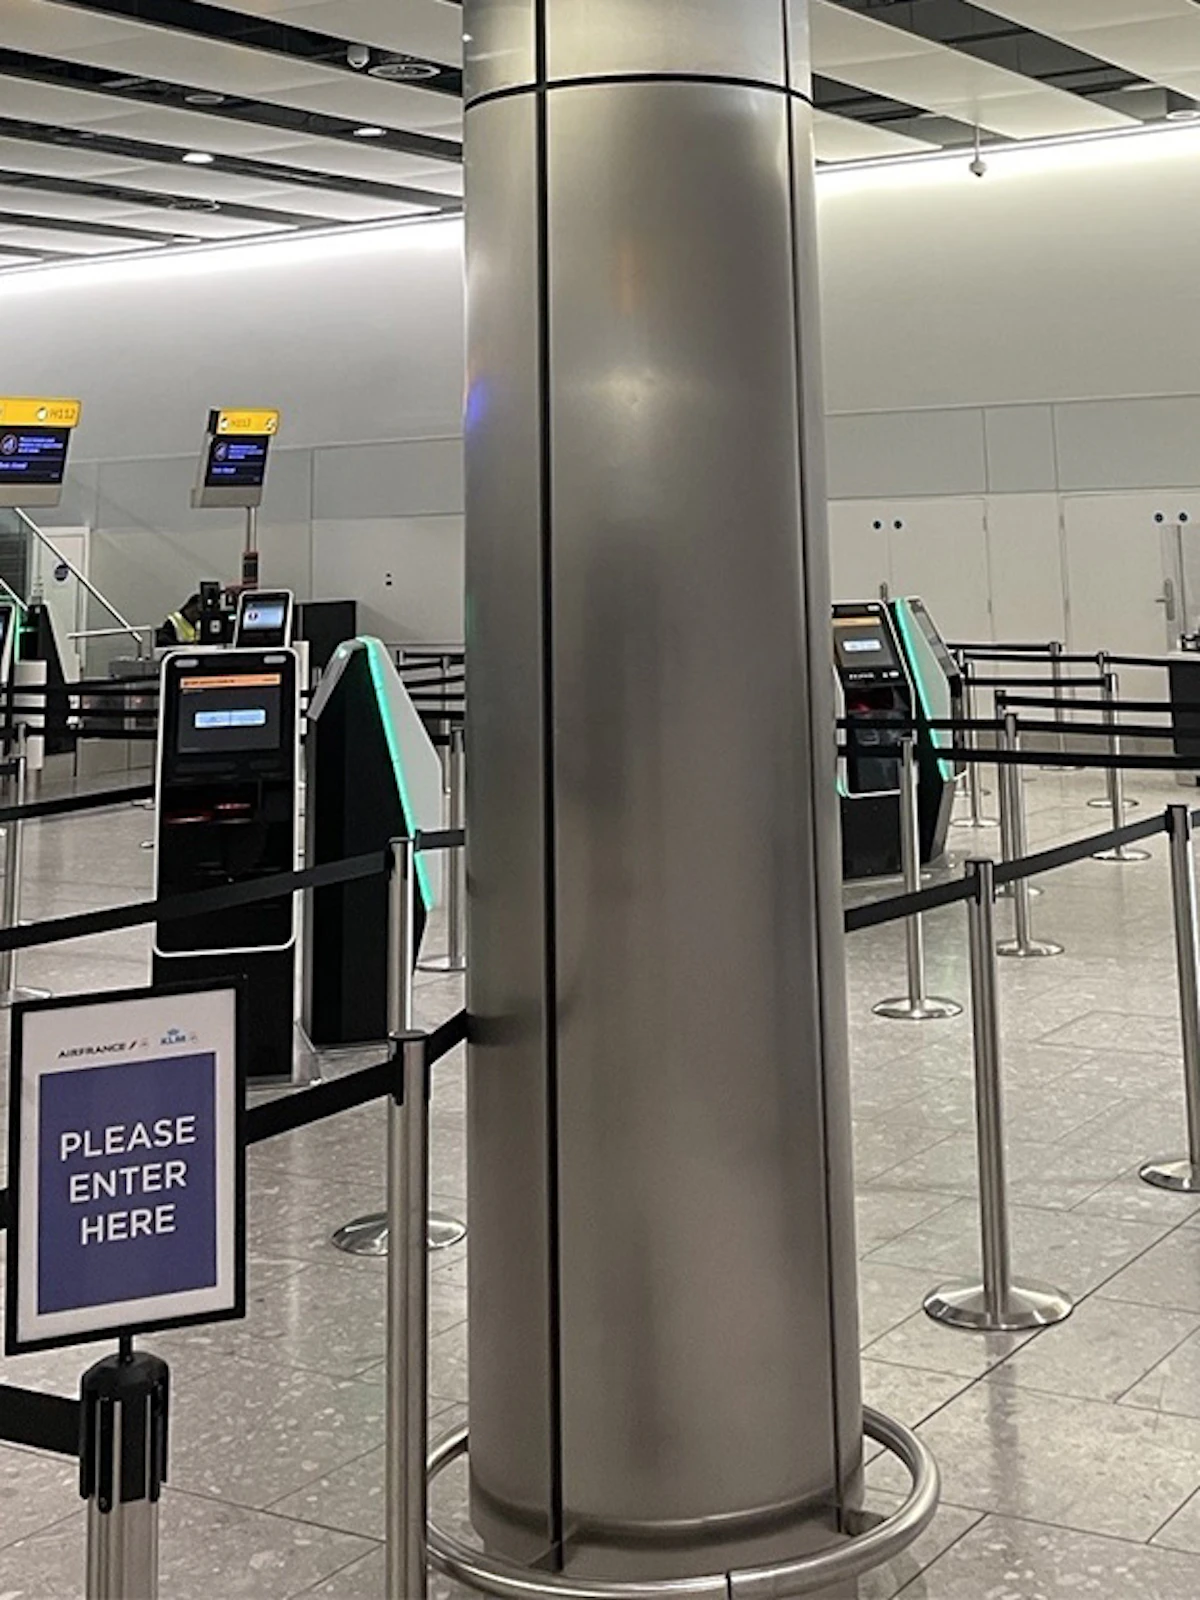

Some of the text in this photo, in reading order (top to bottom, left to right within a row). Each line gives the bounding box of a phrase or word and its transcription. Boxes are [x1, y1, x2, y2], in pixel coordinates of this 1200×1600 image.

[60, 1115, 197, 1161] PLEASE
[69, 1160, 187, 1203] ENTER
[81, 1204, 176, 1245] HERE
